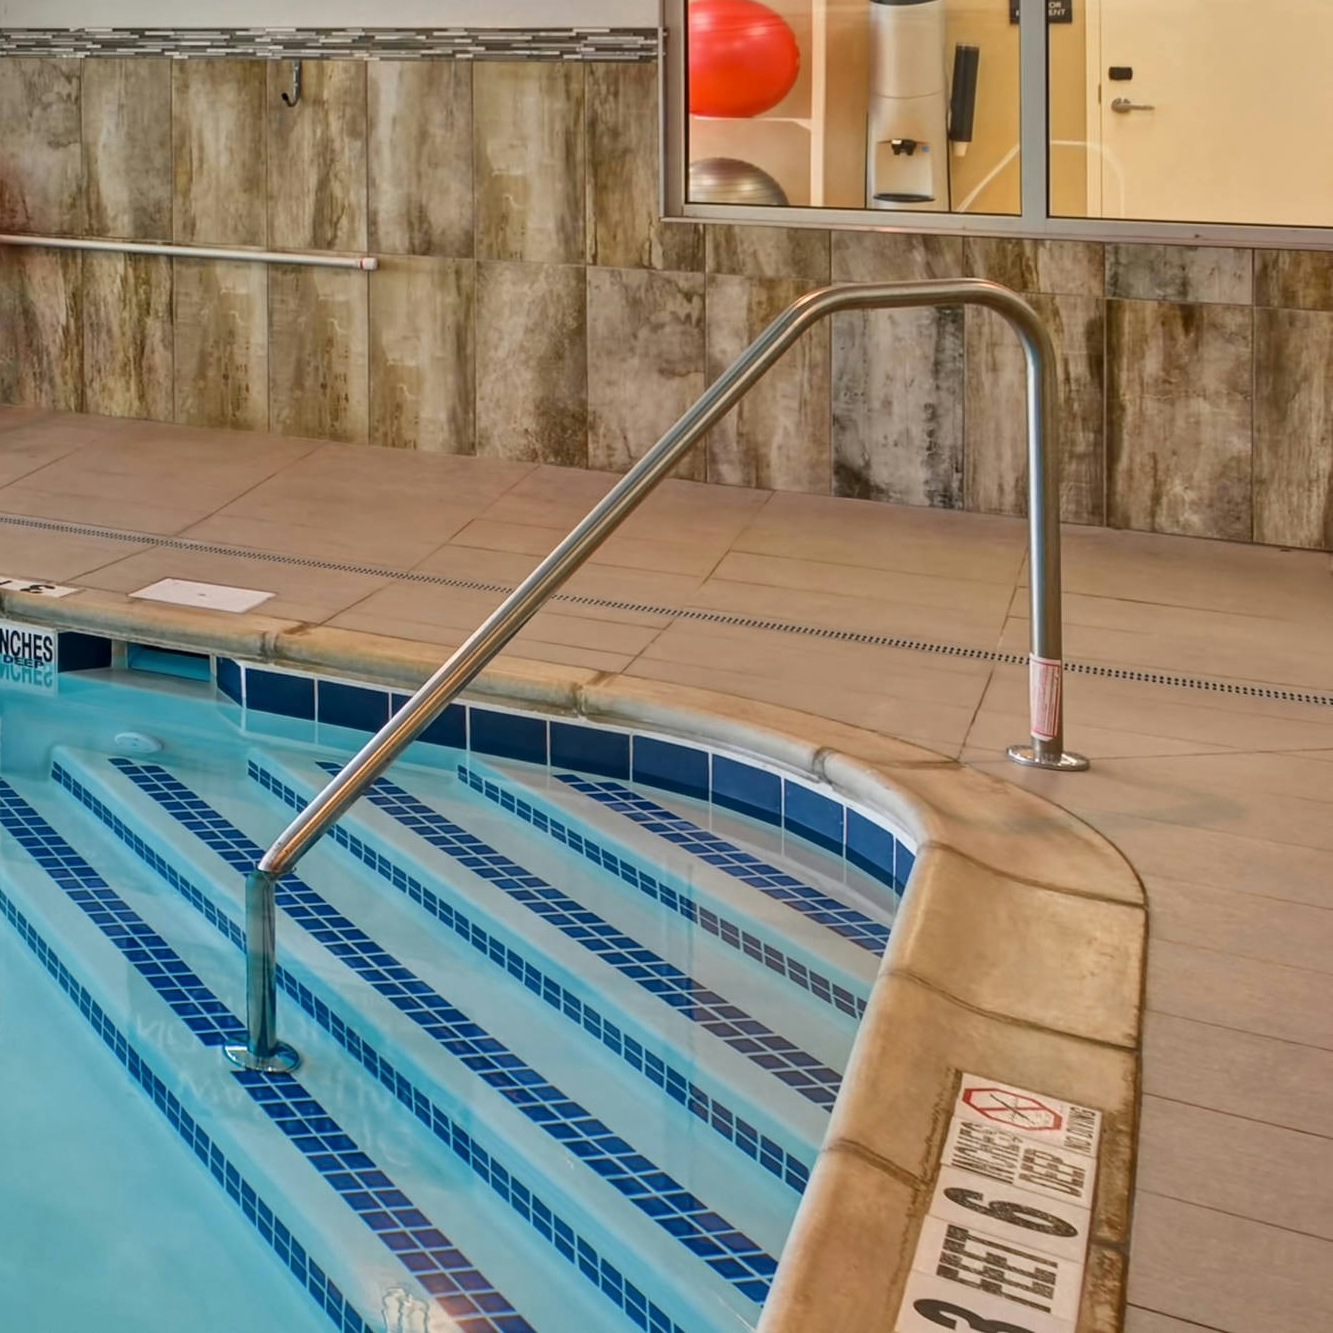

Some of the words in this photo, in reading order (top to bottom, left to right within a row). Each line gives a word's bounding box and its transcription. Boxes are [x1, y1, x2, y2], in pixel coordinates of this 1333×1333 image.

[20, 583, 56, 595] 3
[2, 654, 44, 669] DEEP
[952, 1121, 1023, 1185] INCHES
[1018, 1148, 1086, 1197] DEEP
[943, 1186, 1078, 1238] 6
[936, 1223, 1058, 1314] FEET
